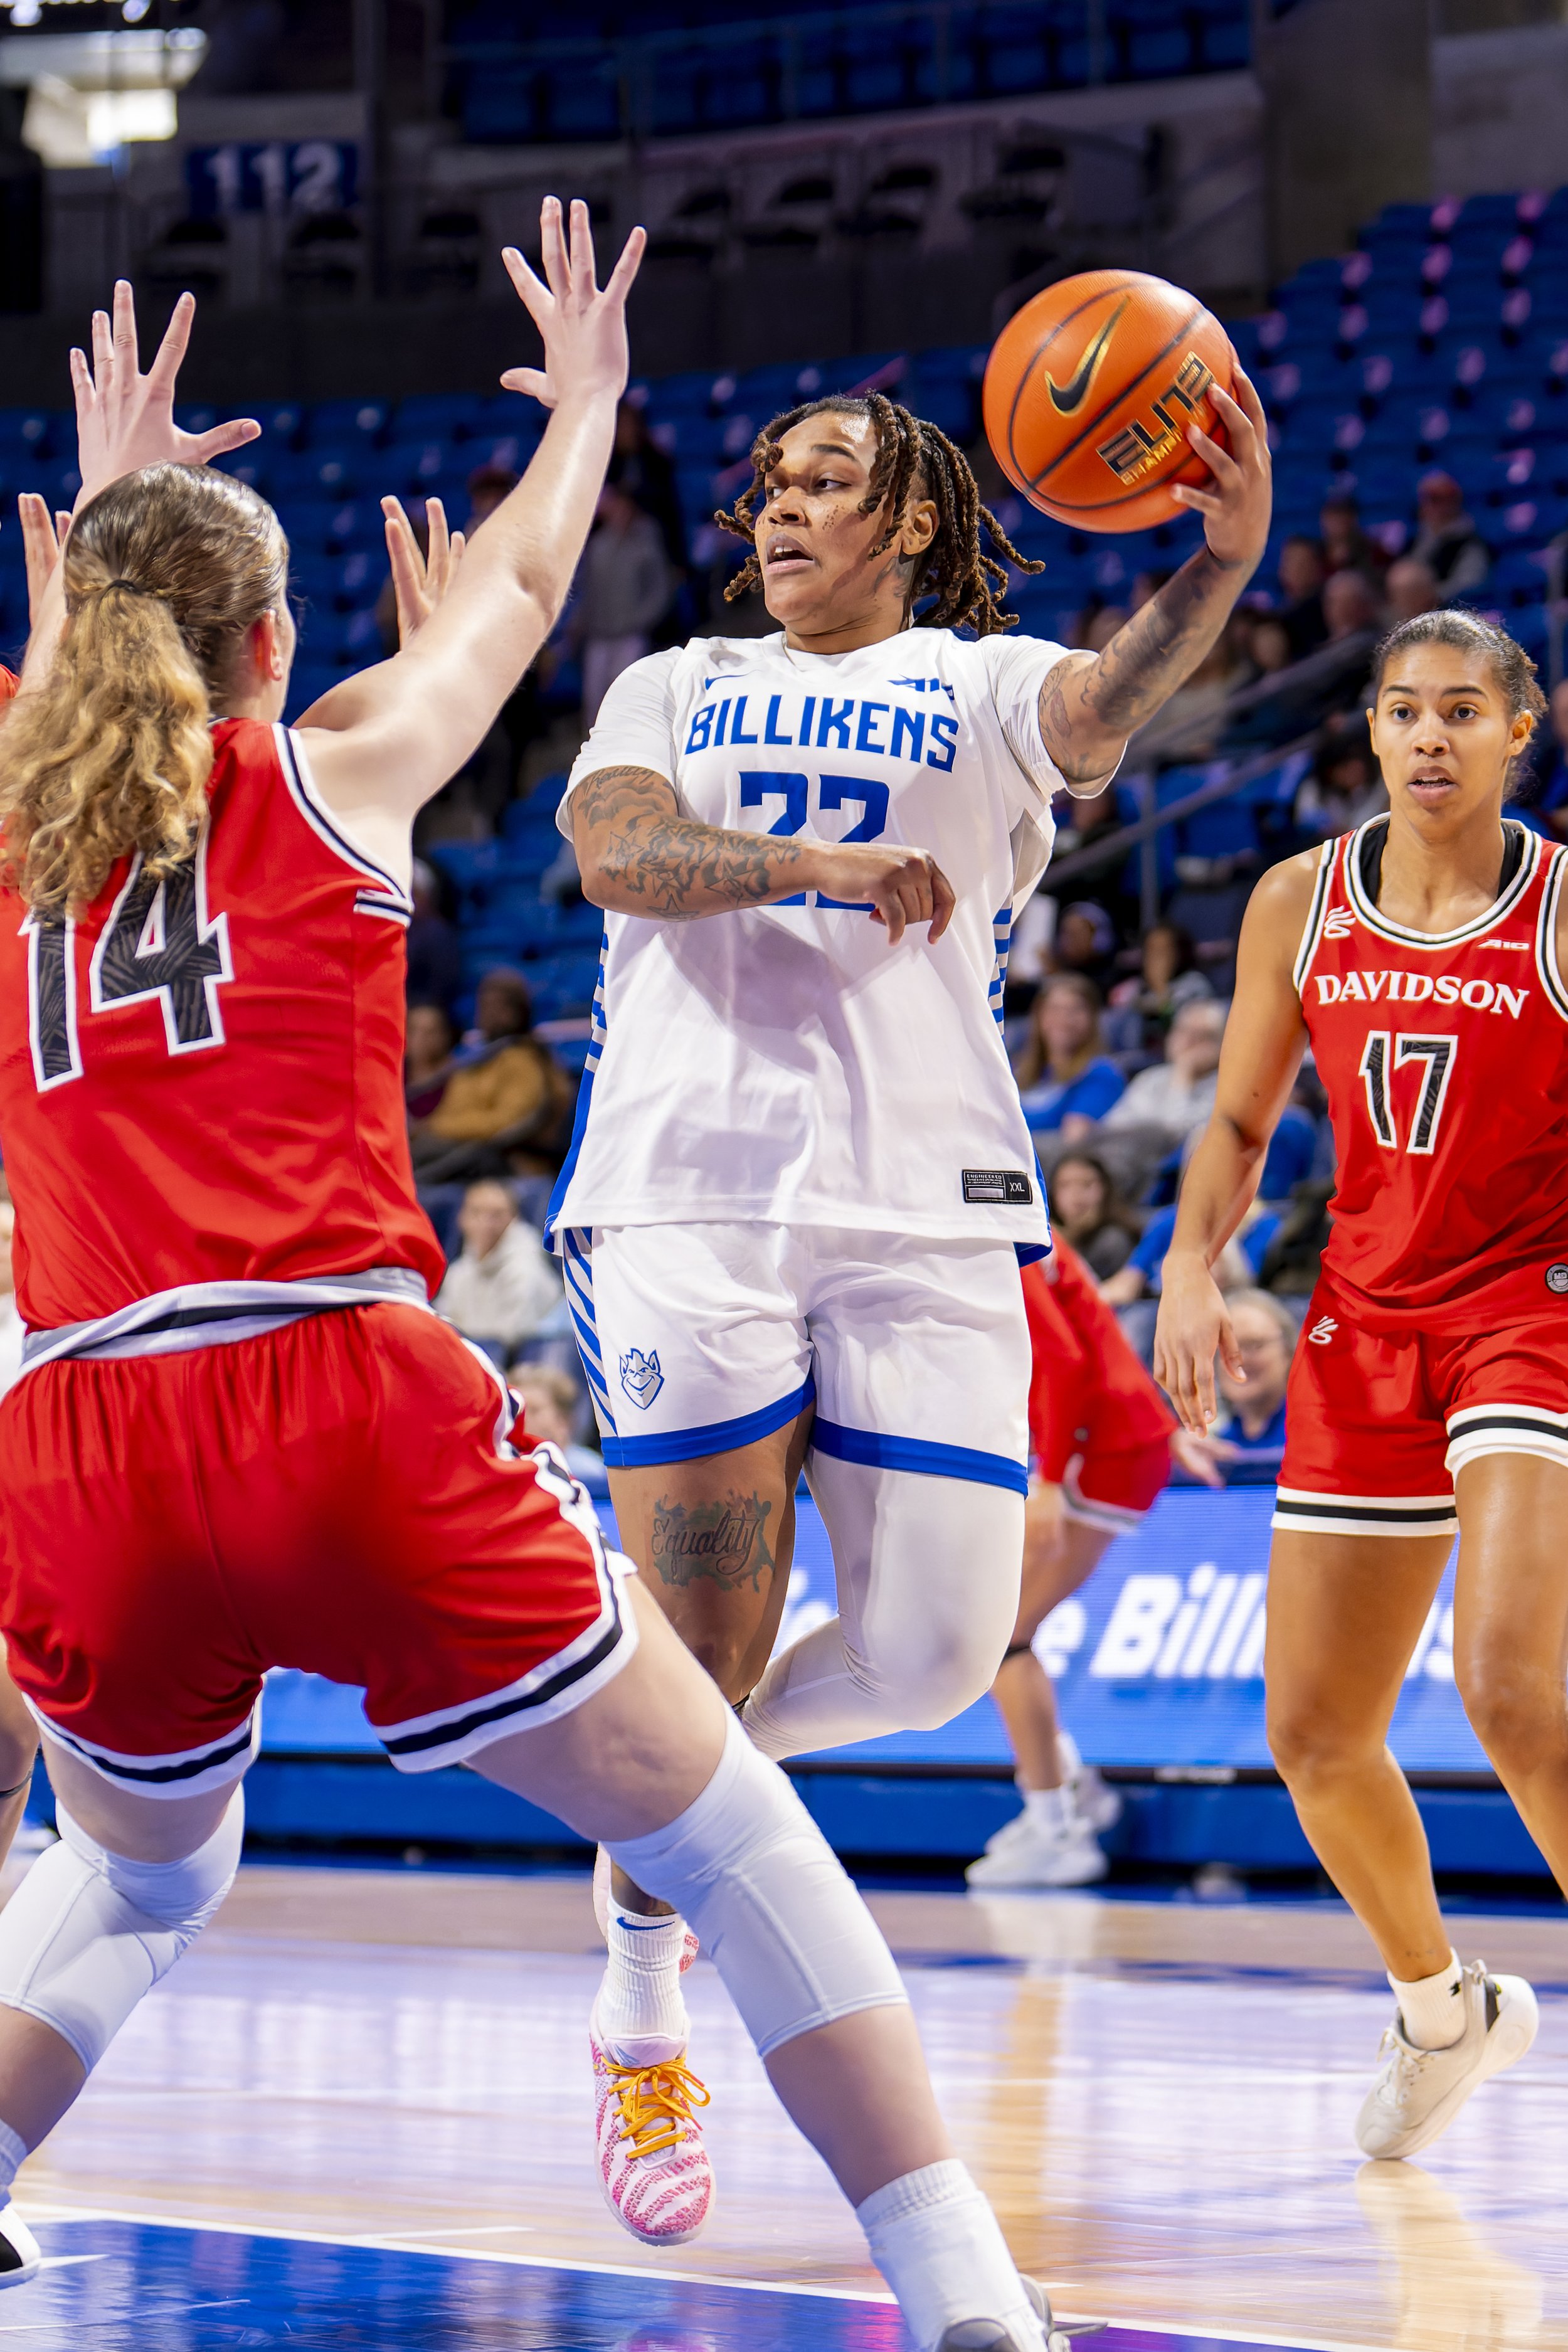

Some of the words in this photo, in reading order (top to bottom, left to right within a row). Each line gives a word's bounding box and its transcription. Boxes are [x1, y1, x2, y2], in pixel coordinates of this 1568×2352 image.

[203, 142, 341, 216] 112
[1095, 351, 1217, 478] ELITE
[685, 694, 959, 773] BILLIKENS
[17, 817, 235, 1093] 14
[1476, 938, 1530, 950] A10
[1315, 970, 1530, 1020] DAVIDSON
[1358, 1030, 1459, 1155] 17
[1009, 1182, 1025, 1192] XXL
[652, 1508, 760, 1579] Equality
